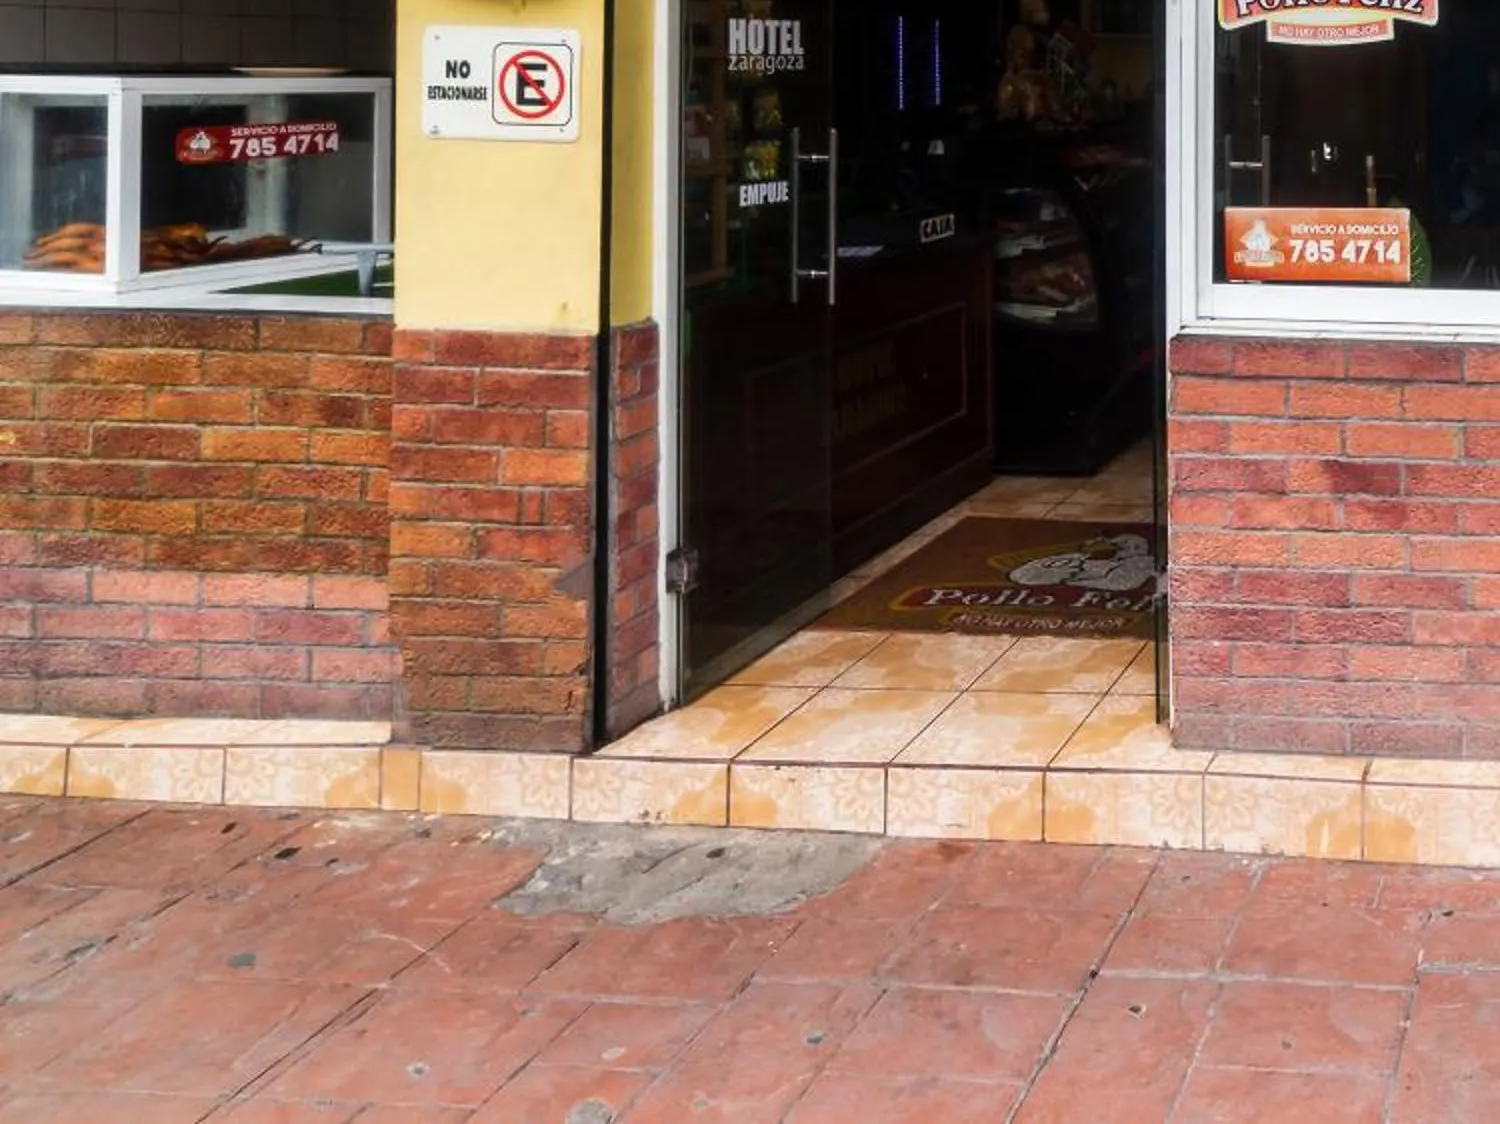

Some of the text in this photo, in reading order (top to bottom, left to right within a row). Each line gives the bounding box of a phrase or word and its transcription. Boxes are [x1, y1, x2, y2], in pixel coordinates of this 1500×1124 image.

[728, 17, 804, 55] HOTEL
[1295, 27, 1315, 38] HAY
[1317, 27, 1345, 38] OTRO
[1345, 24, 1380, 37] MEJOR
[445, 59, 471, 79] NO
[727, 53, 804, 74] zaragoza
[427, 85, 488, 101] ESTACIONARSE
[231, 122, 337, 136] SERVICIO A DOMICILIO
[229, 132, 339, 159] 785 4714
[739, 180, 789, 207] EMPUJE
[1291, 223, 1399, 235] SERVICIO A DOMICILIO
[1289, 239, 1335, 264] 785
[1341, 239, 1402, 264] 4714
[923, 588, 1055, 605] Pollo
